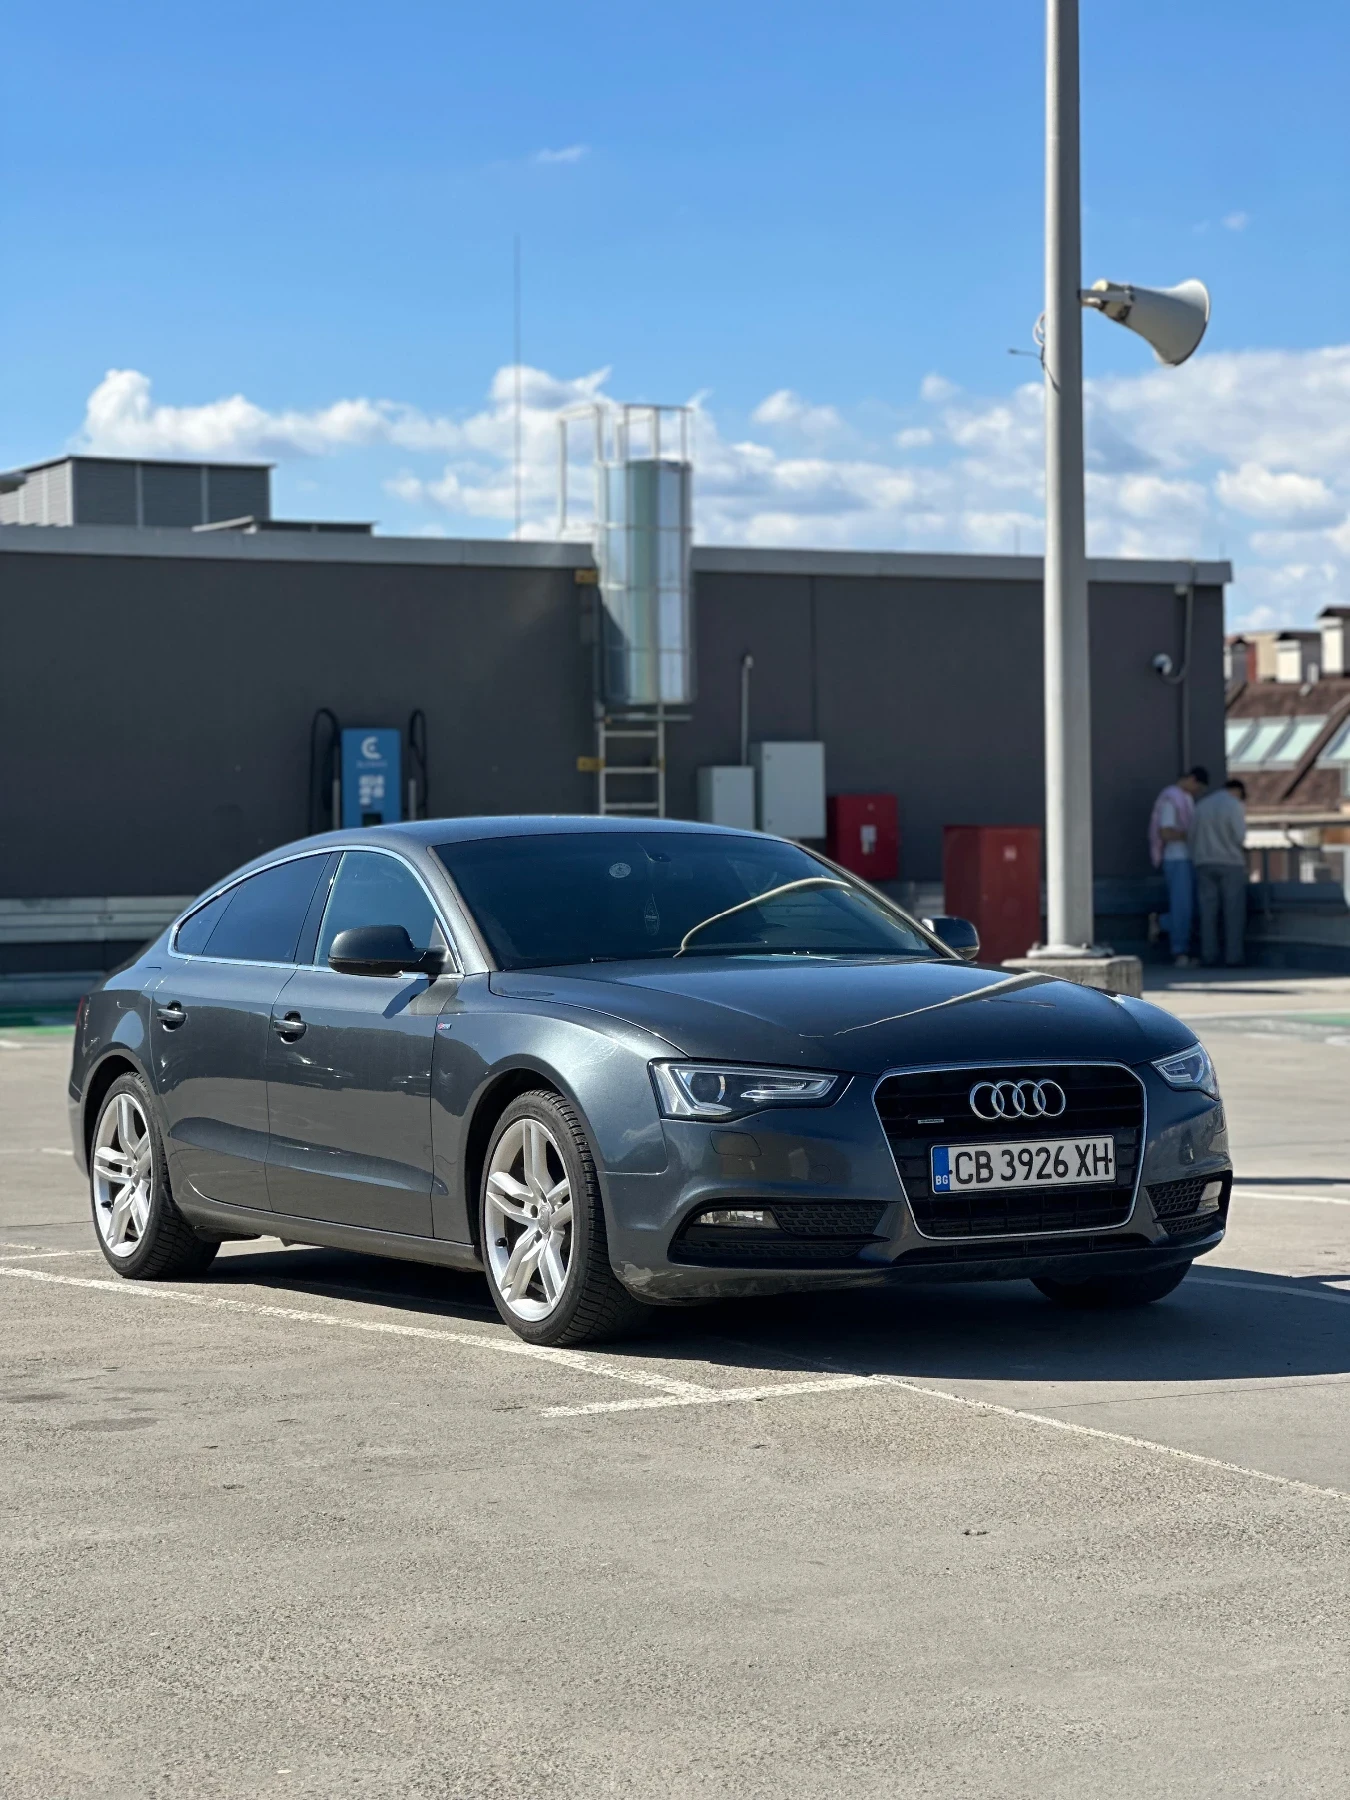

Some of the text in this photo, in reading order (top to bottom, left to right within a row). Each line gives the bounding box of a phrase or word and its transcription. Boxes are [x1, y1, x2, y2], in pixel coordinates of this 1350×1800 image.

[955, 1142, 1110, 1185] CB 3926 XH
[935, 1175, 949, 1186] BG
